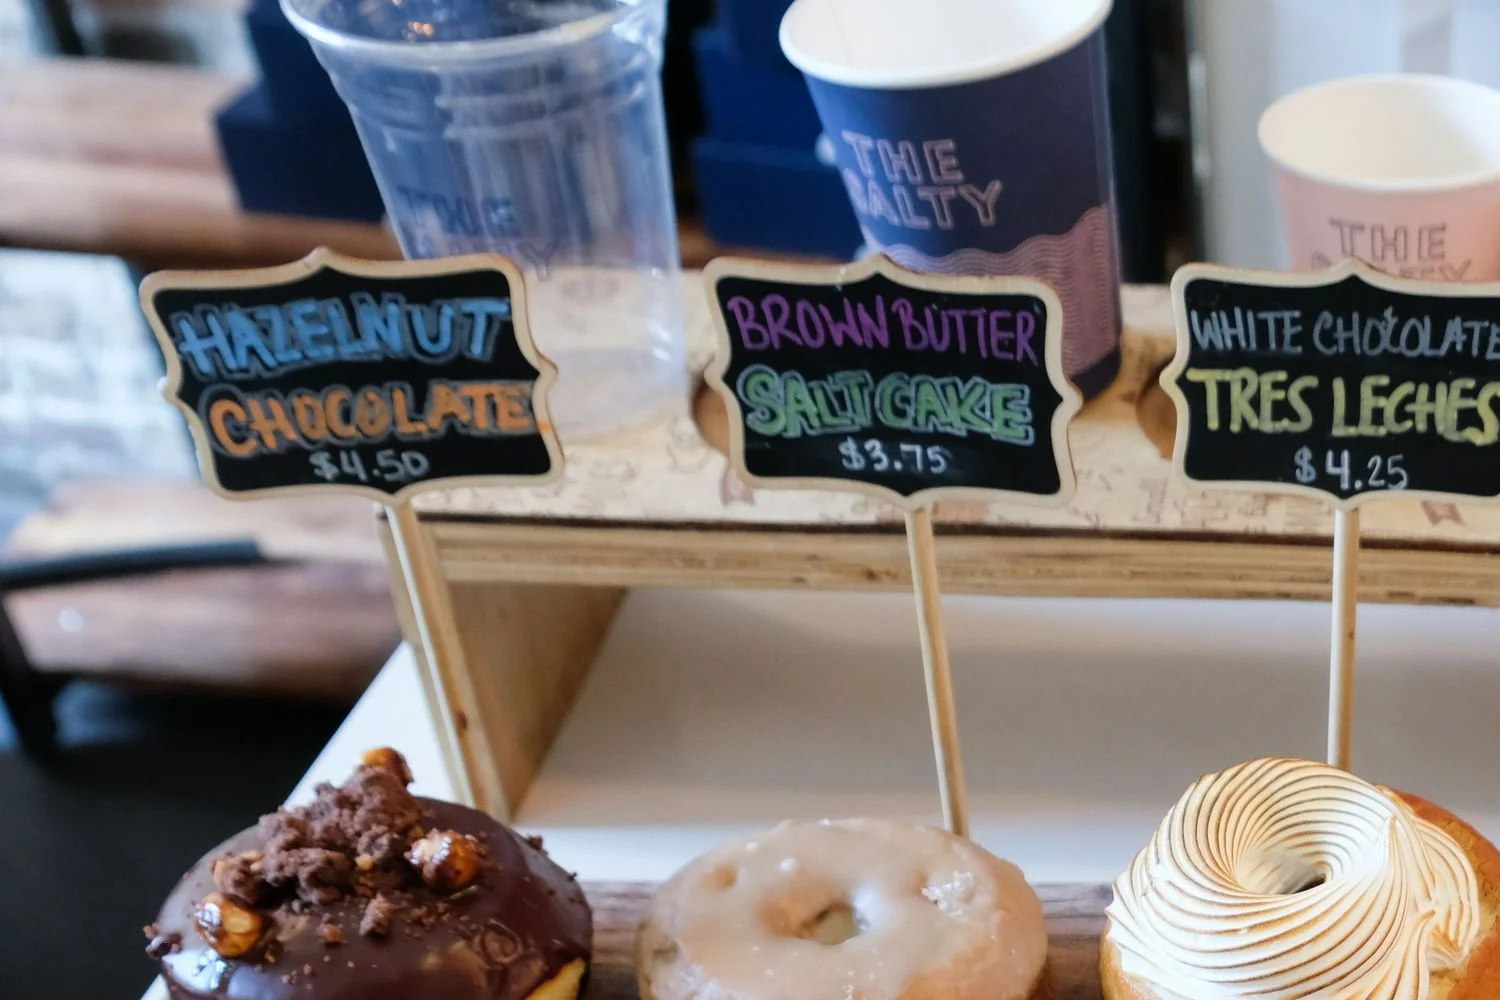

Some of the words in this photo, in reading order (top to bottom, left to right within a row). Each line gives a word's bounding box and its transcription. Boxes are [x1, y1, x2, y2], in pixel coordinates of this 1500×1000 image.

[842, 129, 964, 185] THE
[1329, 217, 1446, 263] THE
[168, 292, 512, 380] HAZELNUT
[728, 294, 890, 350] BROWN
[892, 297, 1038, 366] BUTTER
[1189, 307, 1303, 353] WHITE
[201, 380, 537, 458] CHOCOLATE
[736, 364, 871, 438] SALT
[874, 373, 1035, 446] CAKE
[1186, 367, 1319, 433] TRES
[309, 448, 430, 483] $4.50
[838, 437, 952, 474] $3.75
[1294, 446, 1410, 490] $4.25
